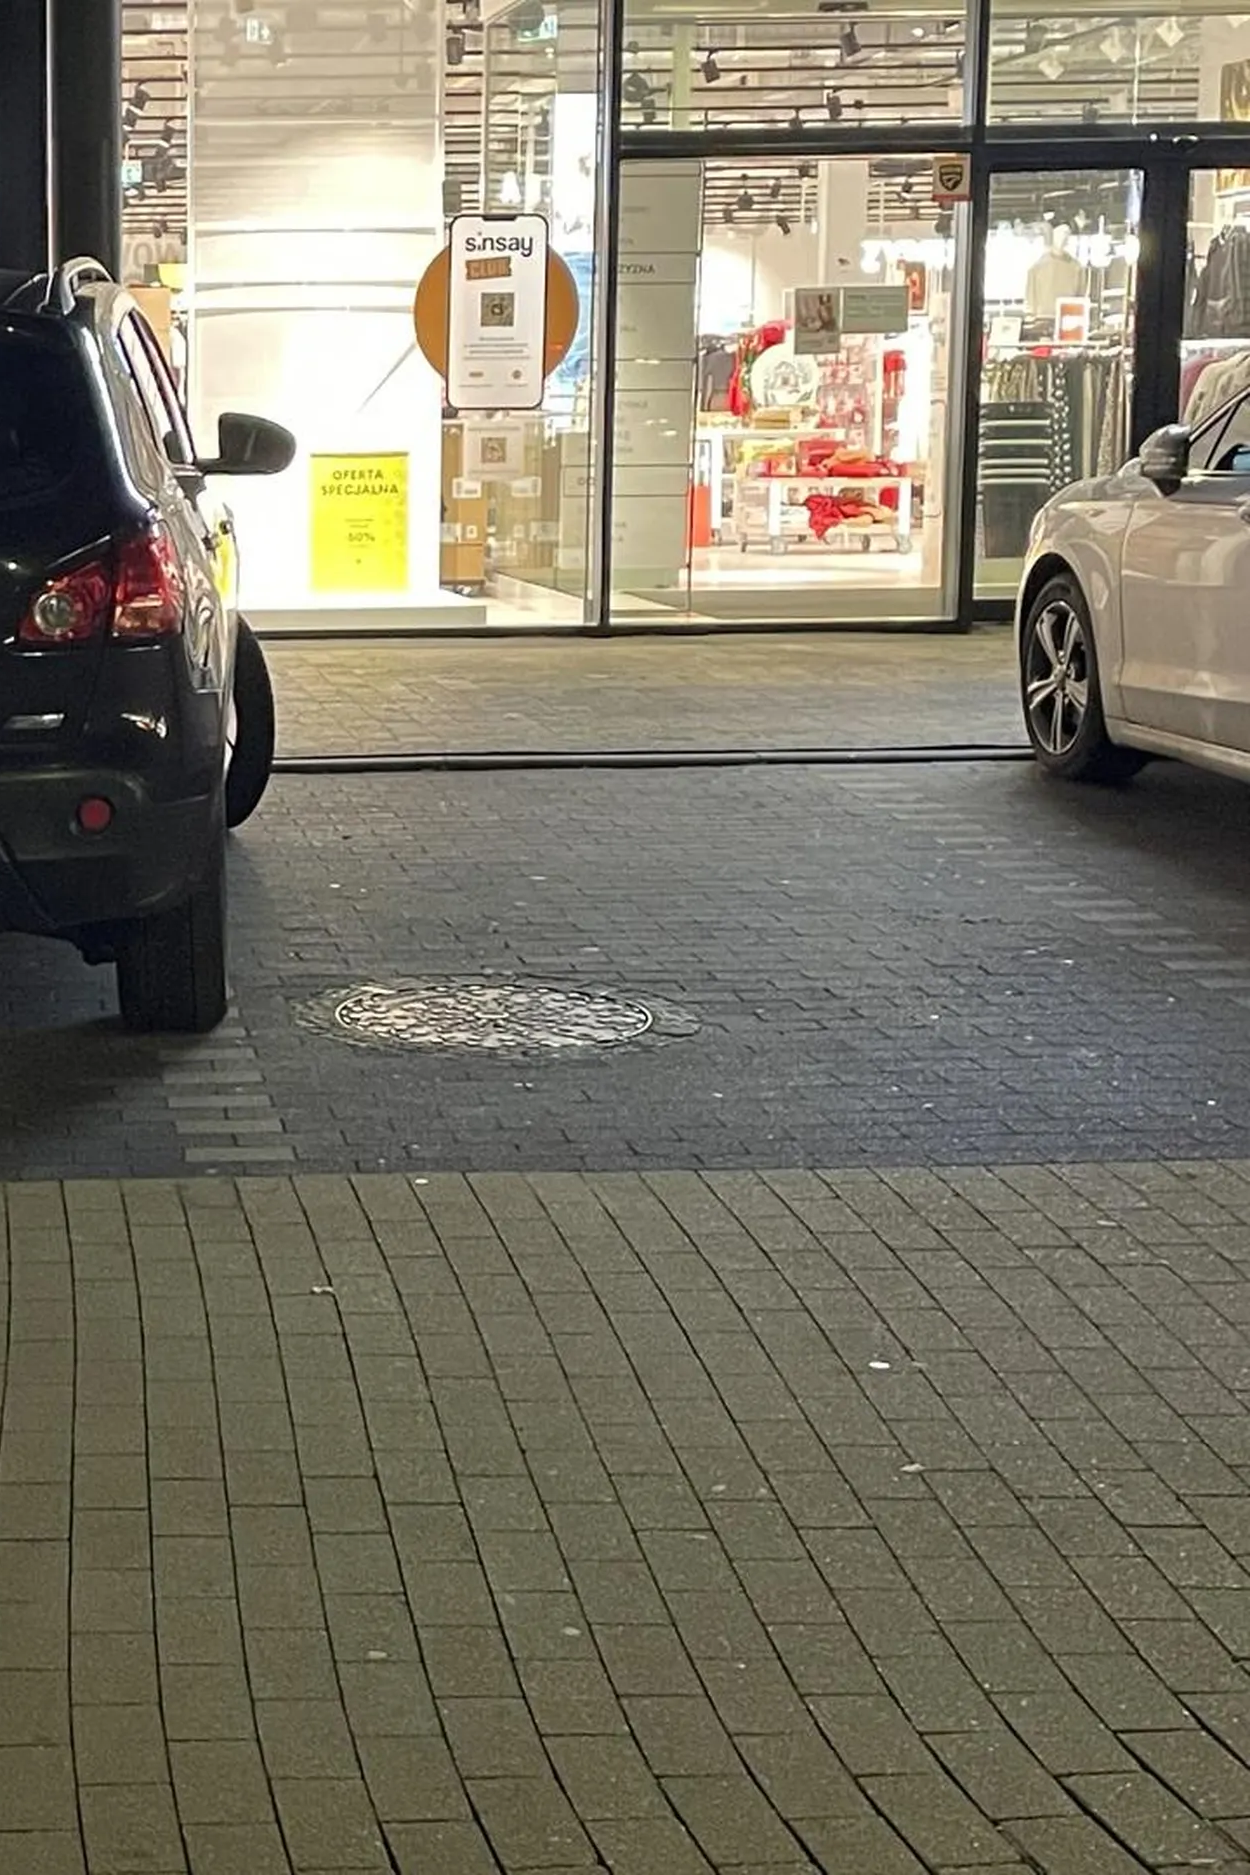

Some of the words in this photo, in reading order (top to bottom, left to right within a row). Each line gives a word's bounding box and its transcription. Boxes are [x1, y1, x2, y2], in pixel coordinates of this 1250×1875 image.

[464, 232, 534, 258] sinsay
[332, 468, 384, 481] OFERTA
[321, 483, 399, 496] SPECJALNA
